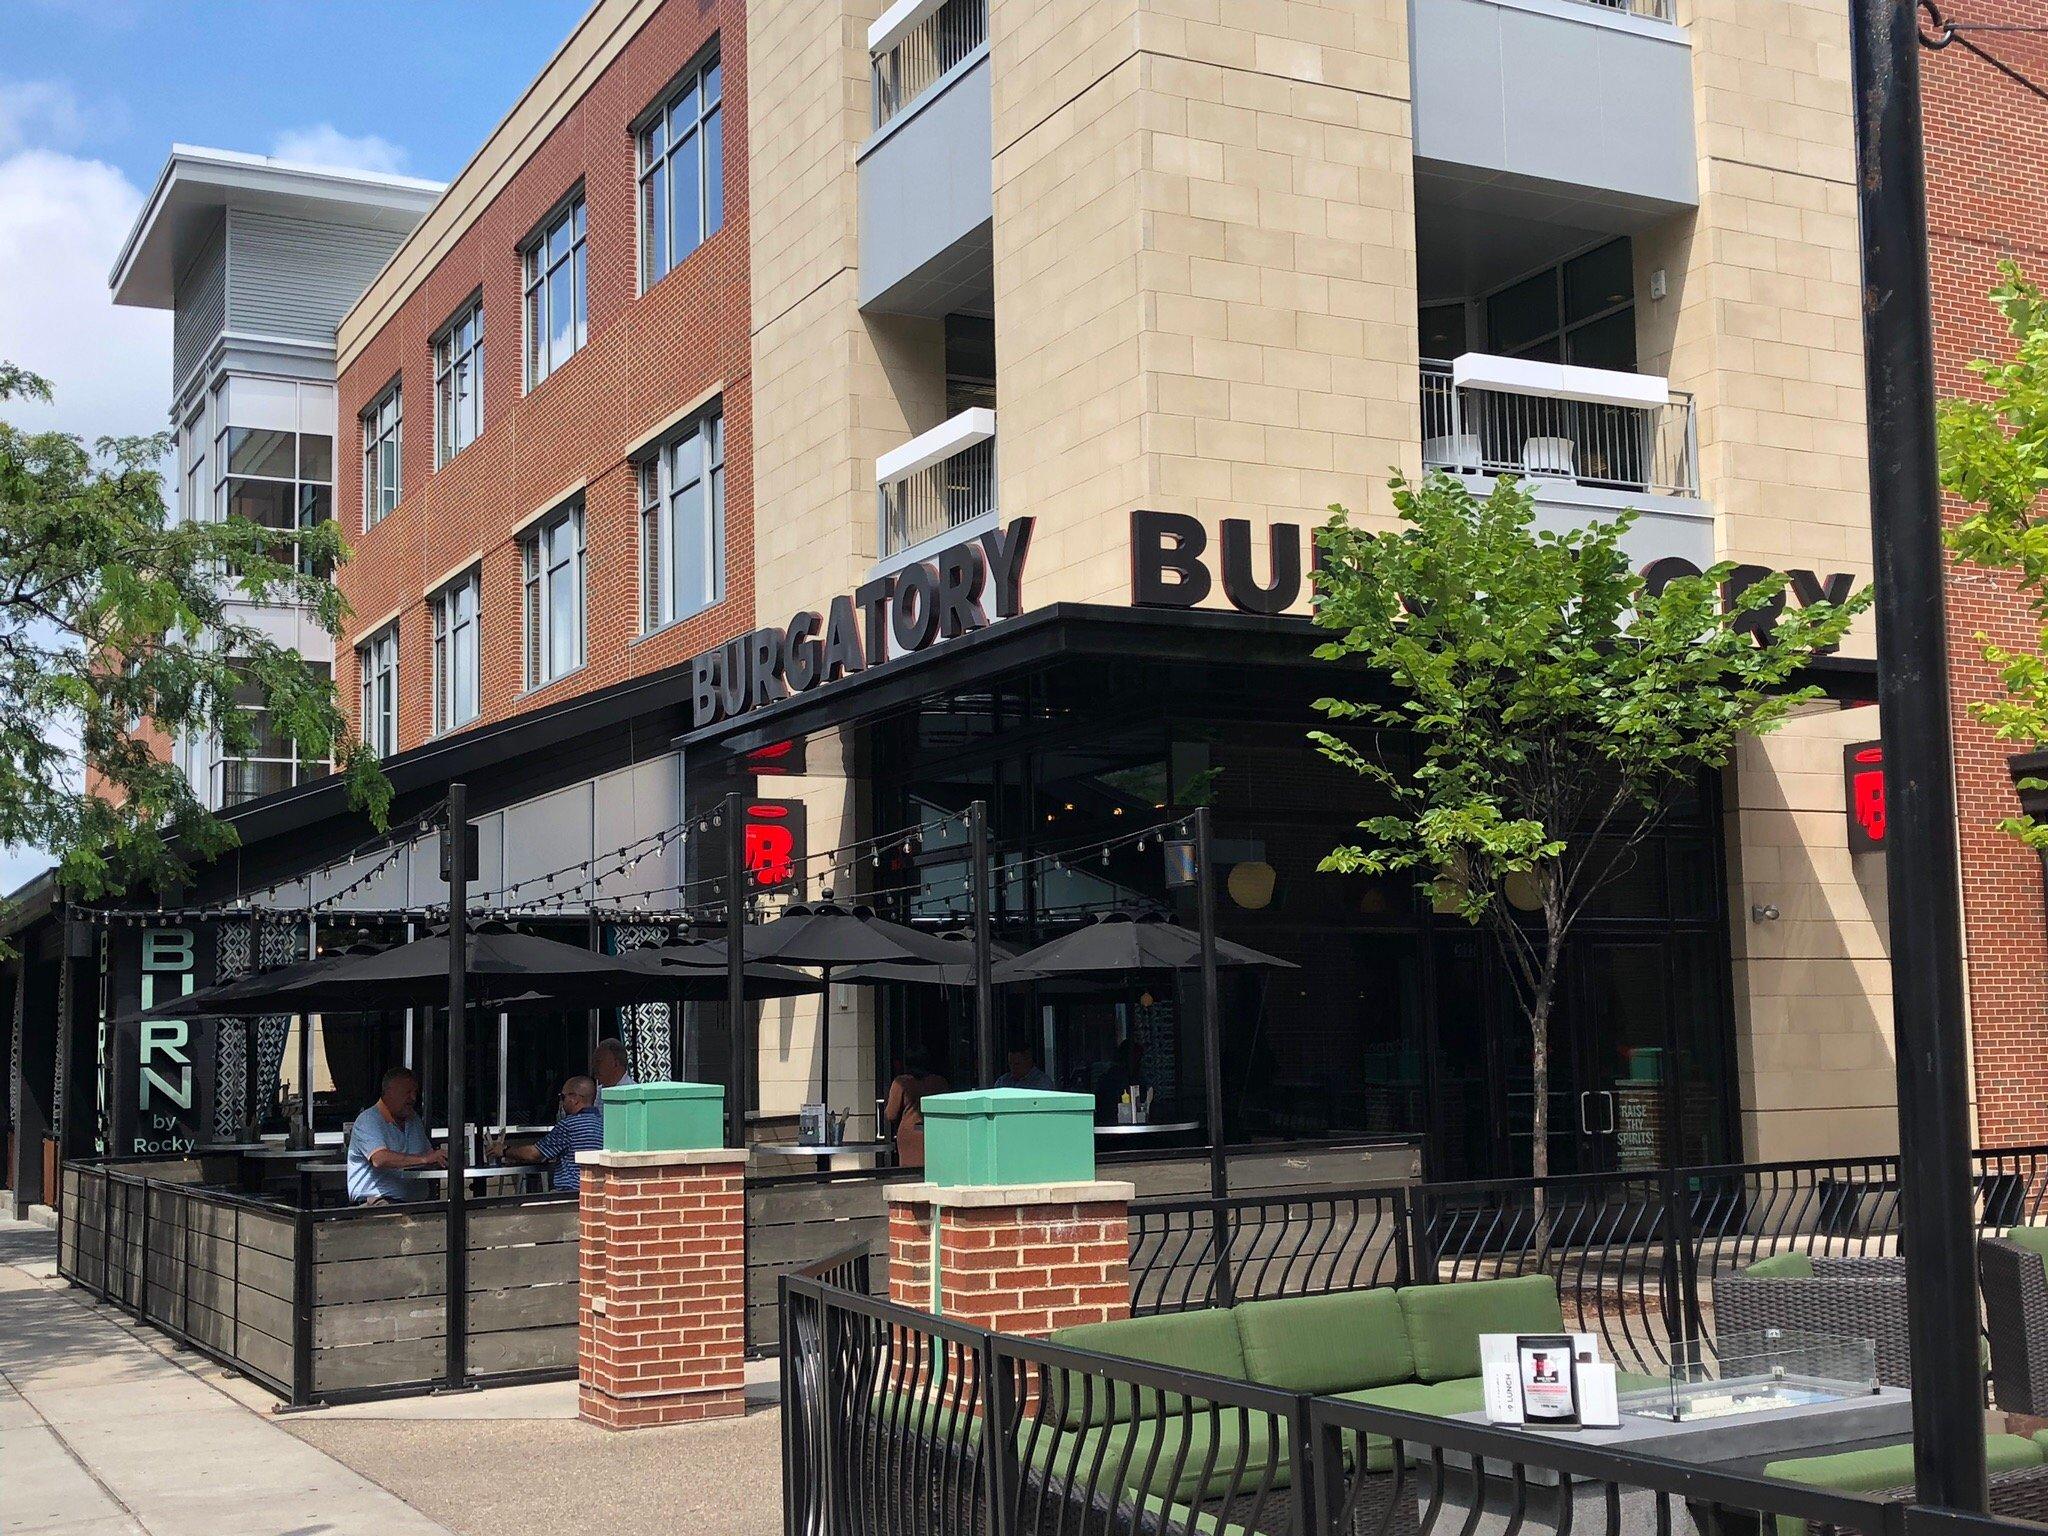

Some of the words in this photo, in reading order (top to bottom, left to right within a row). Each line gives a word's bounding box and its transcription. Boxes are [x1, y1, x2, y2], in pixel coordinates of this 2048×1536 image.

[692, 516, 1036, 728] BURGATORY
[140, 928, 194, 1110] BURN
[1619, 1104, 1648, 1118] RAISE
[152, 1113, 177, 1130] by
[1625, 1118, 1644, 1131] THY
[134, 1136, 196, 1153] Rocky
[1505, 1373, 1514, 1403] LUNCH
